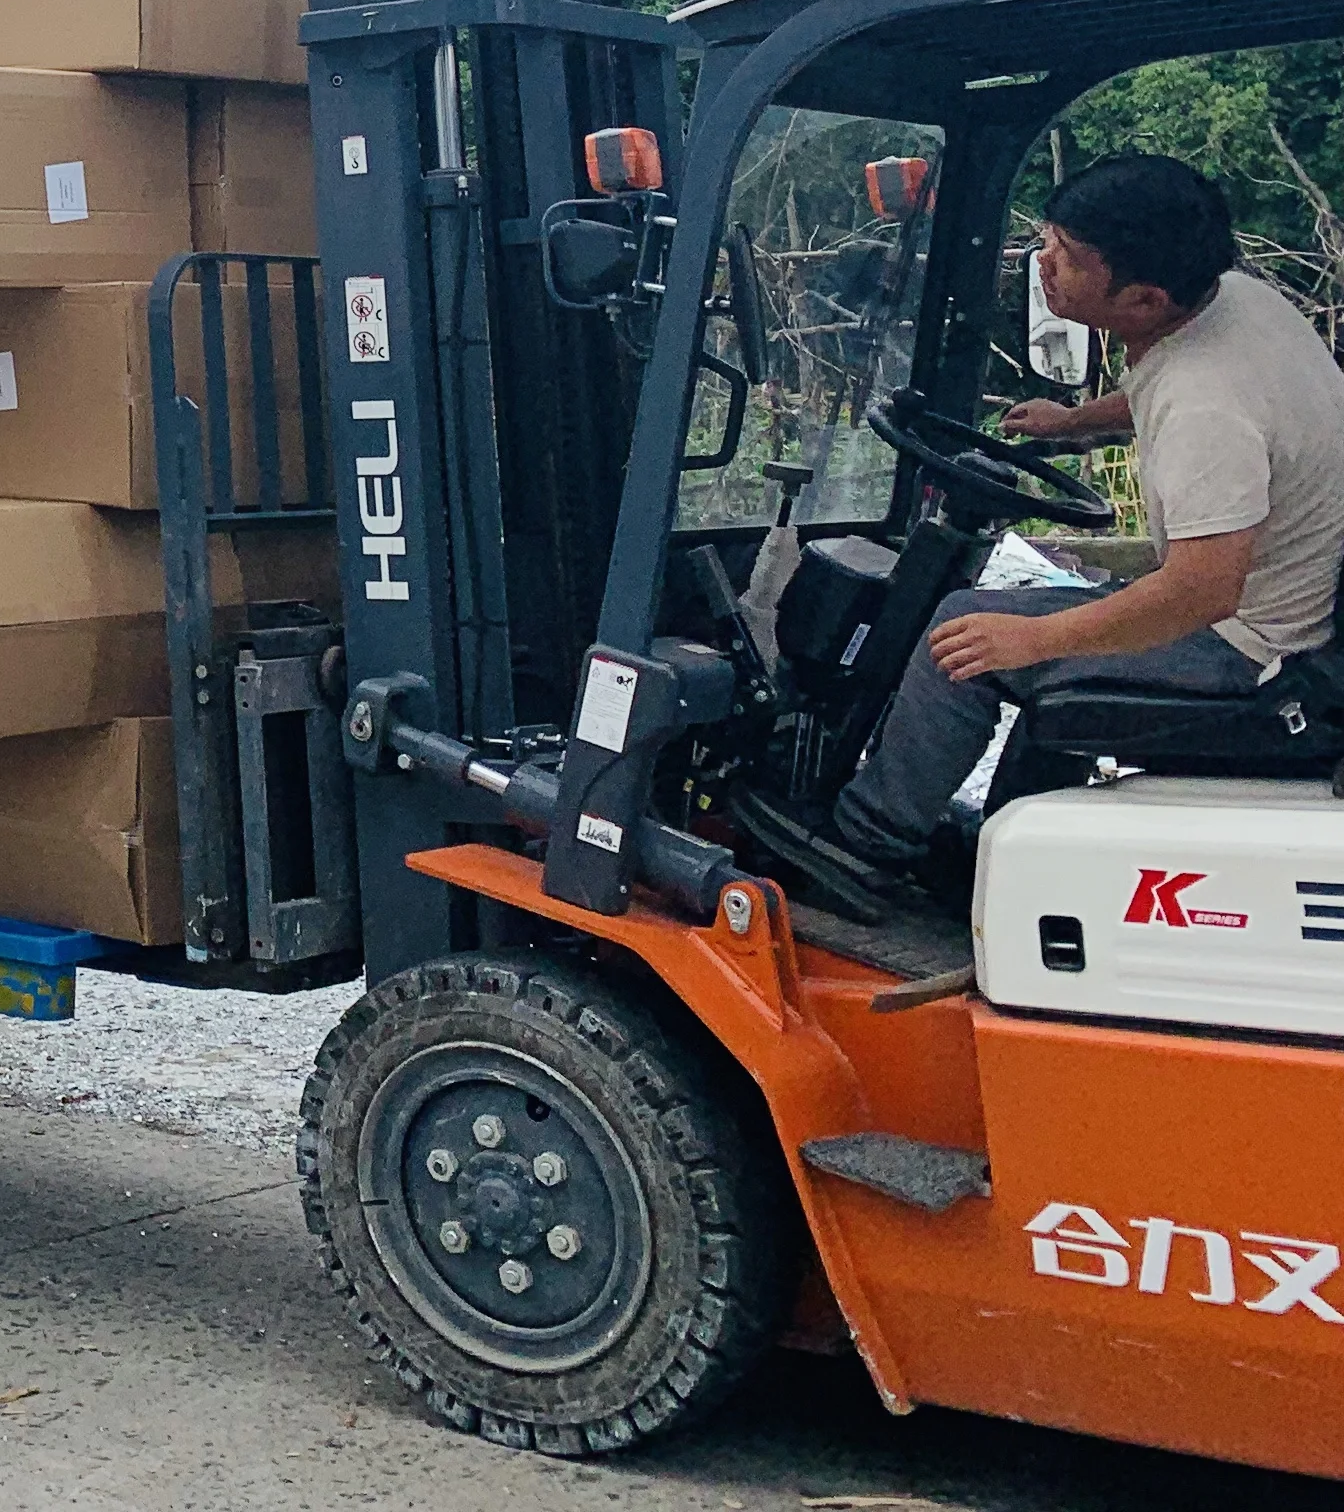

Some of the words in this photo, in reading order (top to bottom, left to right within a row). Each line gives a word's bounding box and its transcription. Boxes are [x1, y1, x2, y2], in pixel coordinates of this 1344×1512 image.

[351, 399, 410, 601] HELI
[1123, 868, 1208, 928] K
[1022, 1202, 1344, 1324] 合力叉
